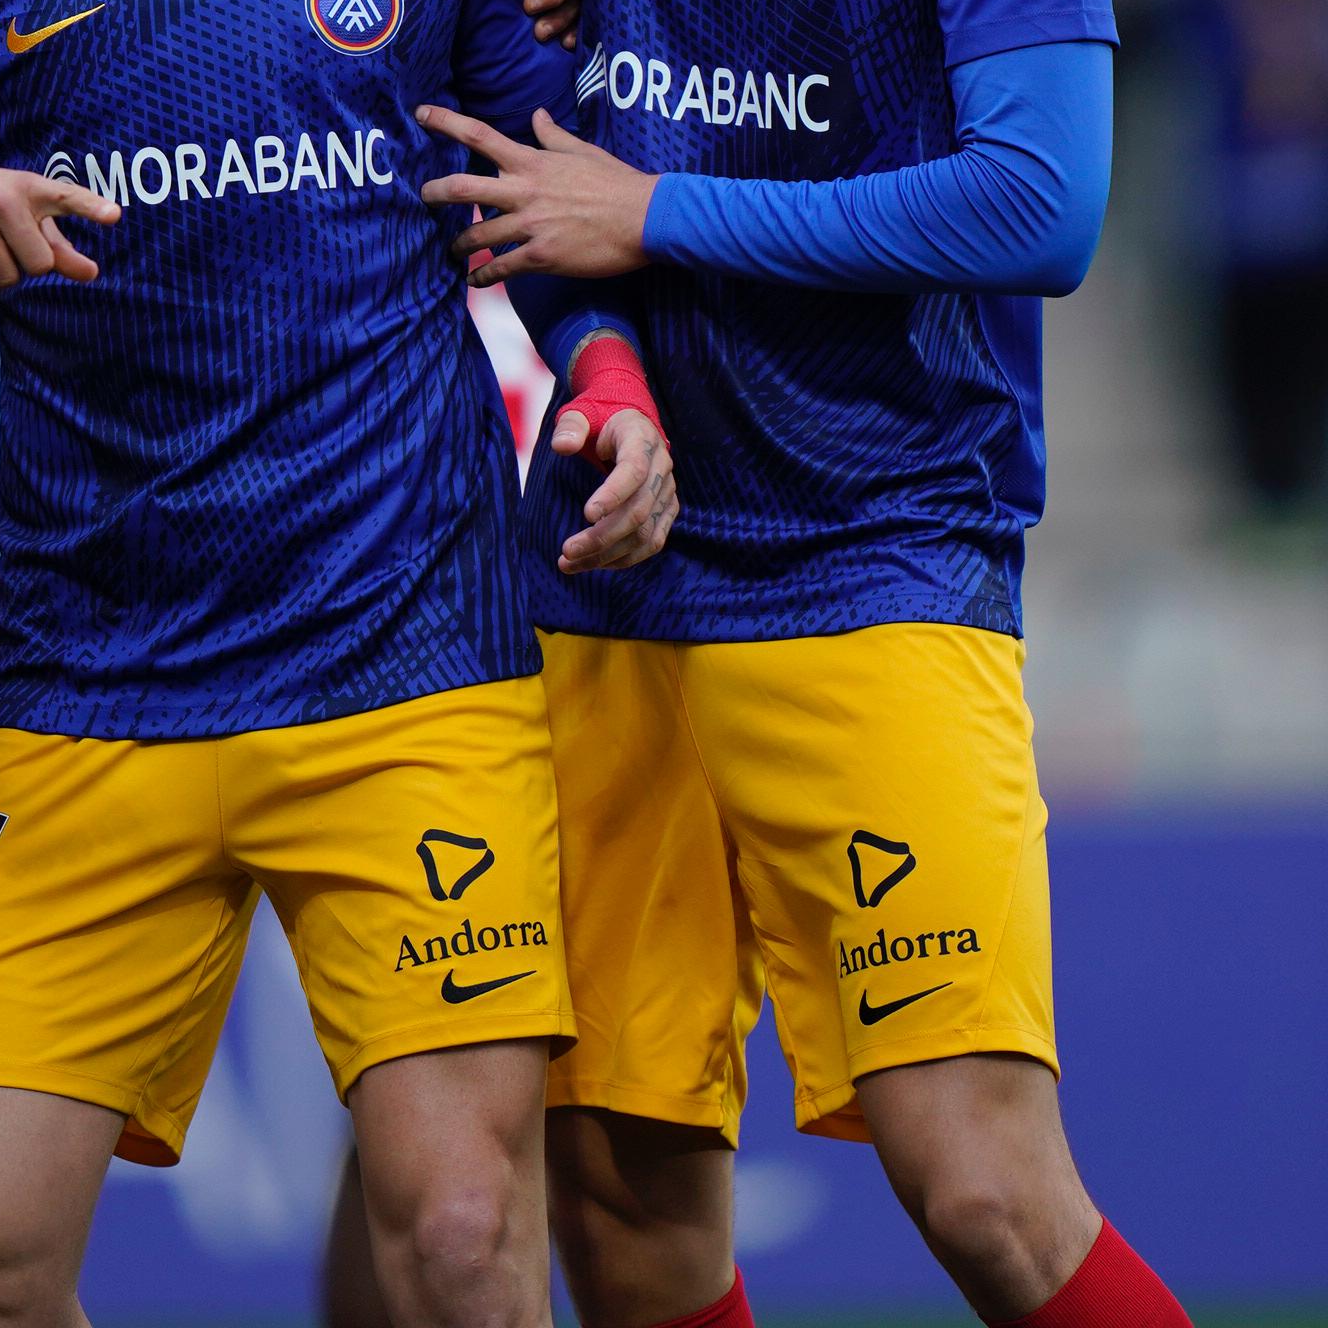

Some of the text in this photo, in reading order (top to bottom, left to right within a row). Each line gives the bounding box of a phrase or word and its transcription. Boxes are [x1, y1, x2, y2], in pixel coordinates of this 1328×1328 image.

[602, 50, 830, 133] ORABANC
[84, 128, 393, 207] MORABANC
[394, 918, 548, 972] Andorra
[840, 928, 981, 978] Andorra
